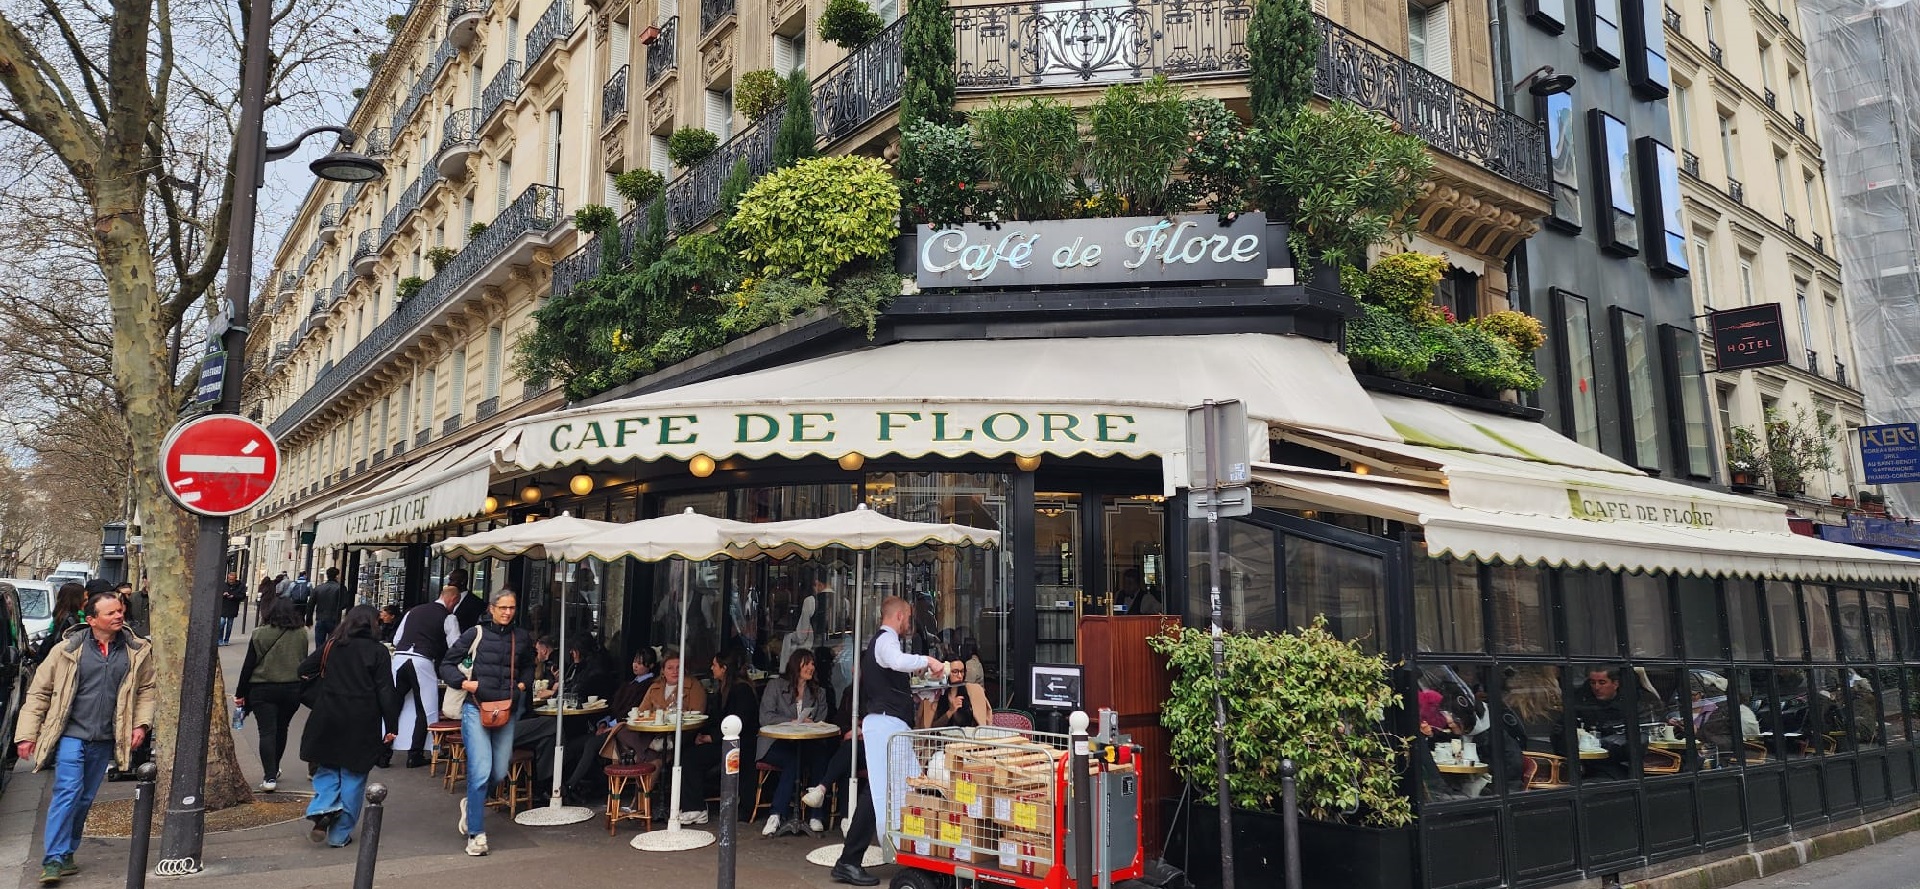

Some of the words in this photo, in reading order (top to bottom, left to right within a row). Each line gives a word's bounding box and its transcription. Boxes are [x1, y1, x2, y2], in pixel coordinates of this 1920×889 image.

[921, 229, 1041, 281] Café
[1052, 236, 1102, 268] de
[1123, 219, 1260, 270] Flore
[1727, 339, 1773, 352] HOTEL
[550, 414, 700, 452] CAFE
[734, 412, 836, 443] DE
[876, 412, 1138, 443] FLORE
[1583, 500, 1631, 520] CAFE
[1636, 505, 1658, 521] DE
[1663, 507, 1714, 526] FLORE
